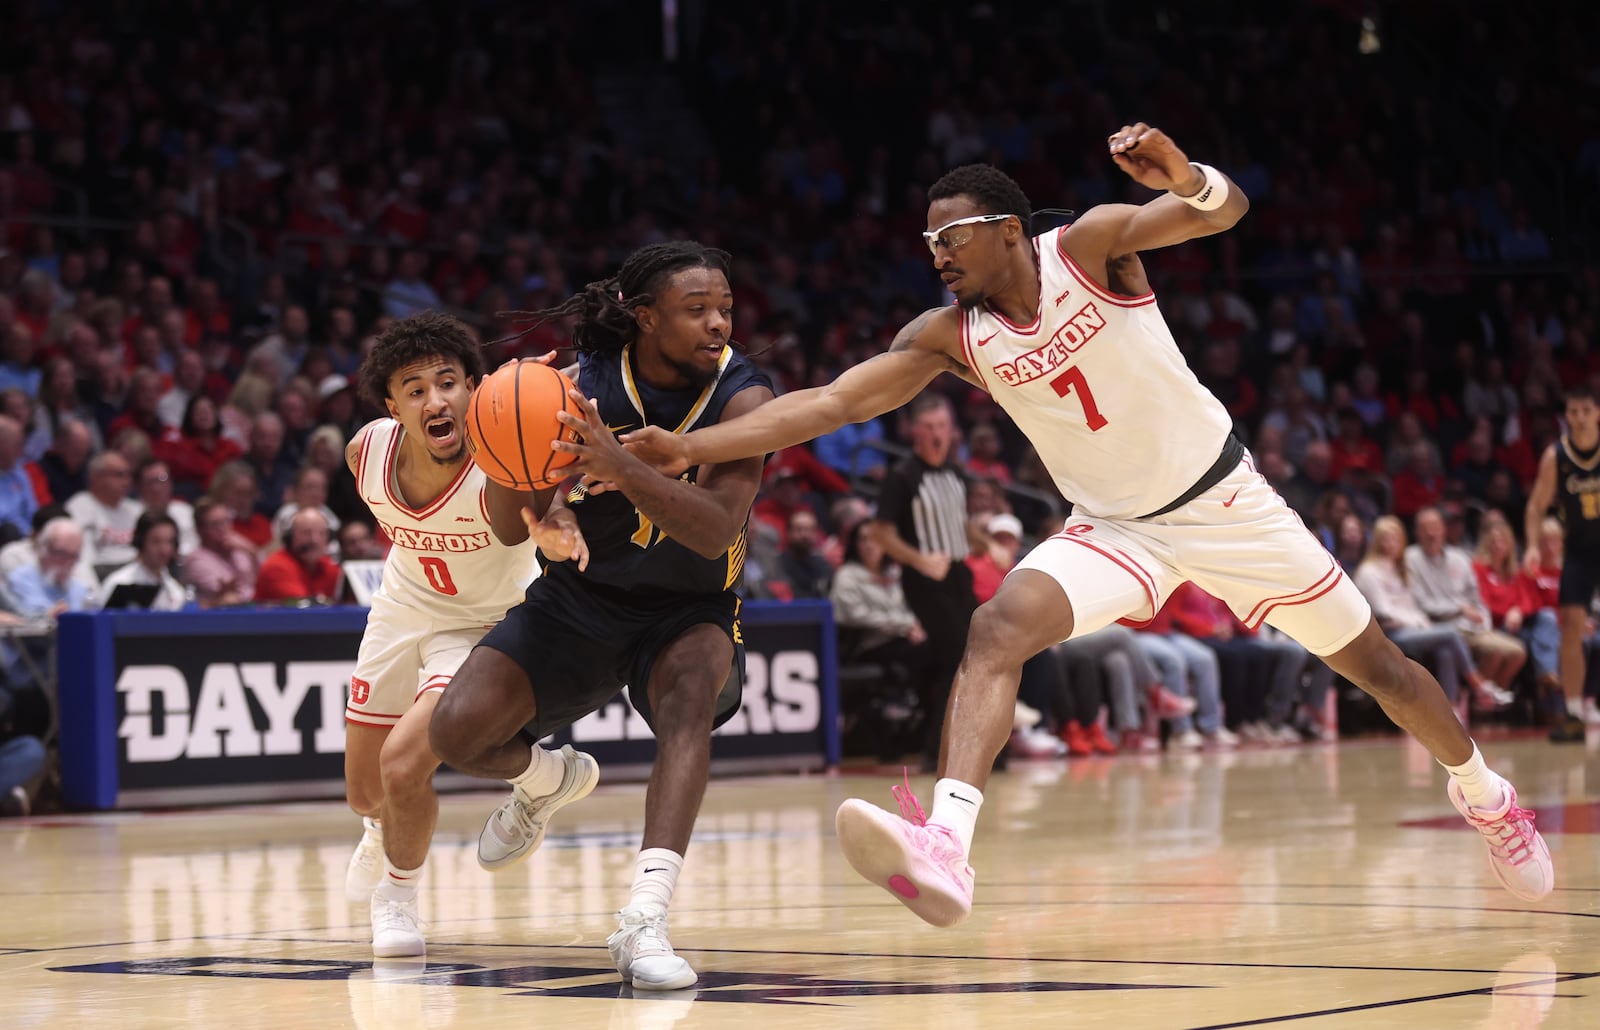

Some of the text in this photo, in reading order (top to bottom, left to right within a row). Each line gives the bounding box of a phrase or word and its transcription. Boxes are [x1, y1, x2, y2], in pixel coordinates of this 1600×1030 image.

[993, 301, 1107, 387] DAYTON
[1049, 365, 1109, 432] 7
[418, 556, 458, 596] 0
[116, 660, 358, 763] DAYT
